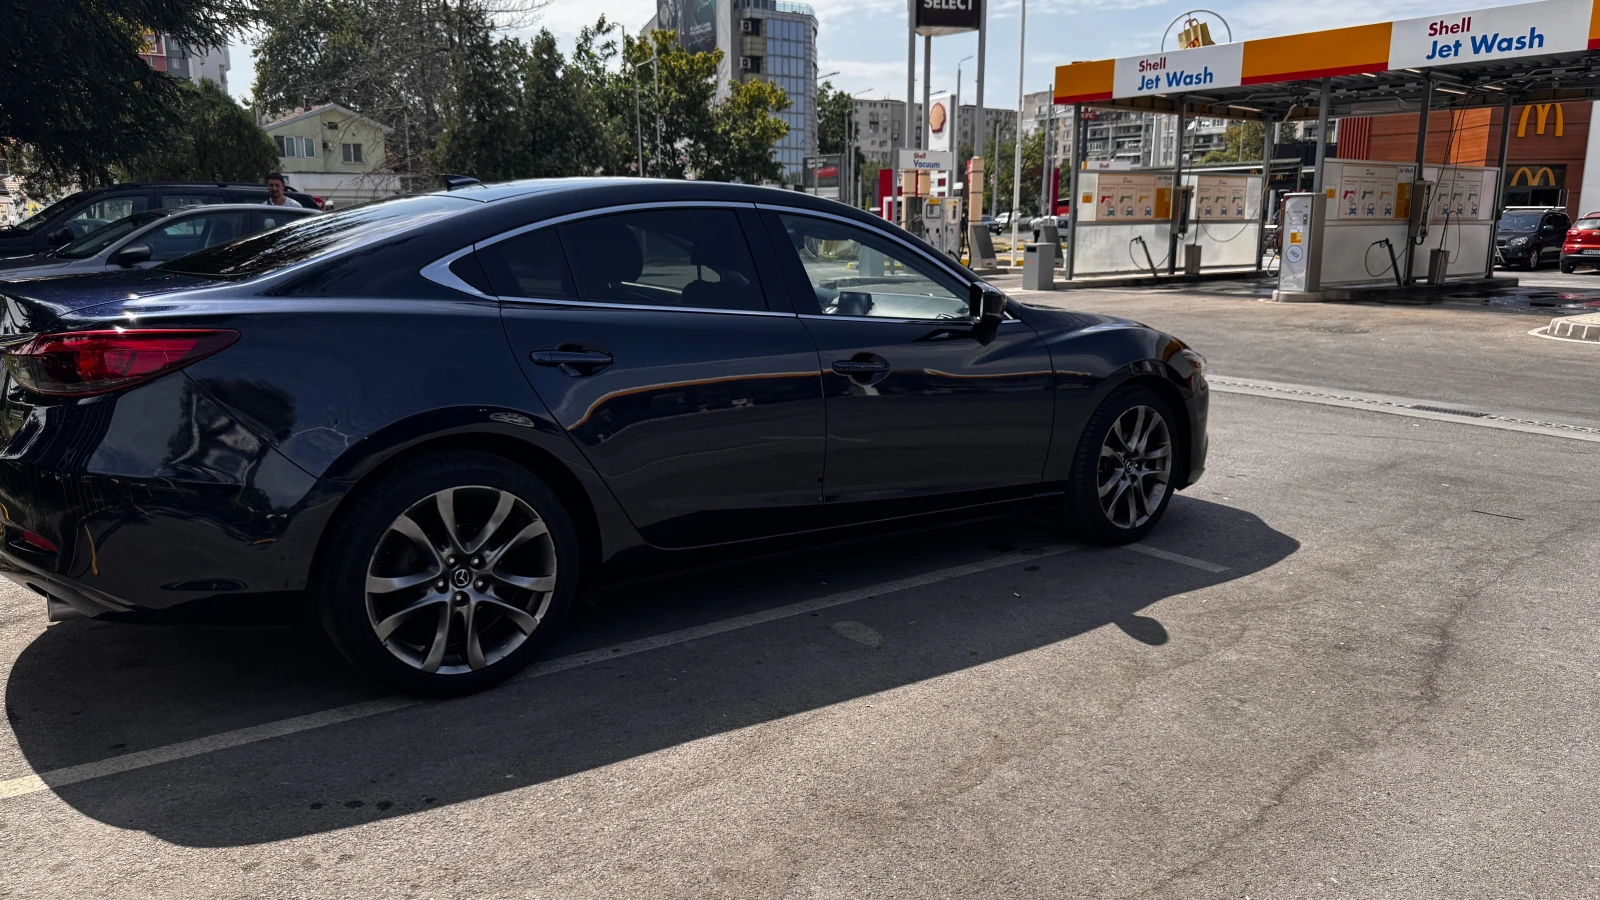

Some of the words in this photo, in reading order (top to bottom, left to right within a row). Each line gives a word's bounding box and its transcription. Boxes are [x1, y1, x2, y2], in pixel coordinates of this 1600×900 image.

[923, 0, 973, 10] SELECT
[1428, 16, 1472, 37] Shell
[1425, 39, 1462, 60] Jet
[1470, 26, 1545, 55] Wash
[1138, 56, 1167, 73] Shell
[1137, 74, 1161, 91] Jet
[1165, 65, 1214, 88] Wash
[913, 152, 927, 160] Shell
[913, 159, 941, 168] Vacuum
